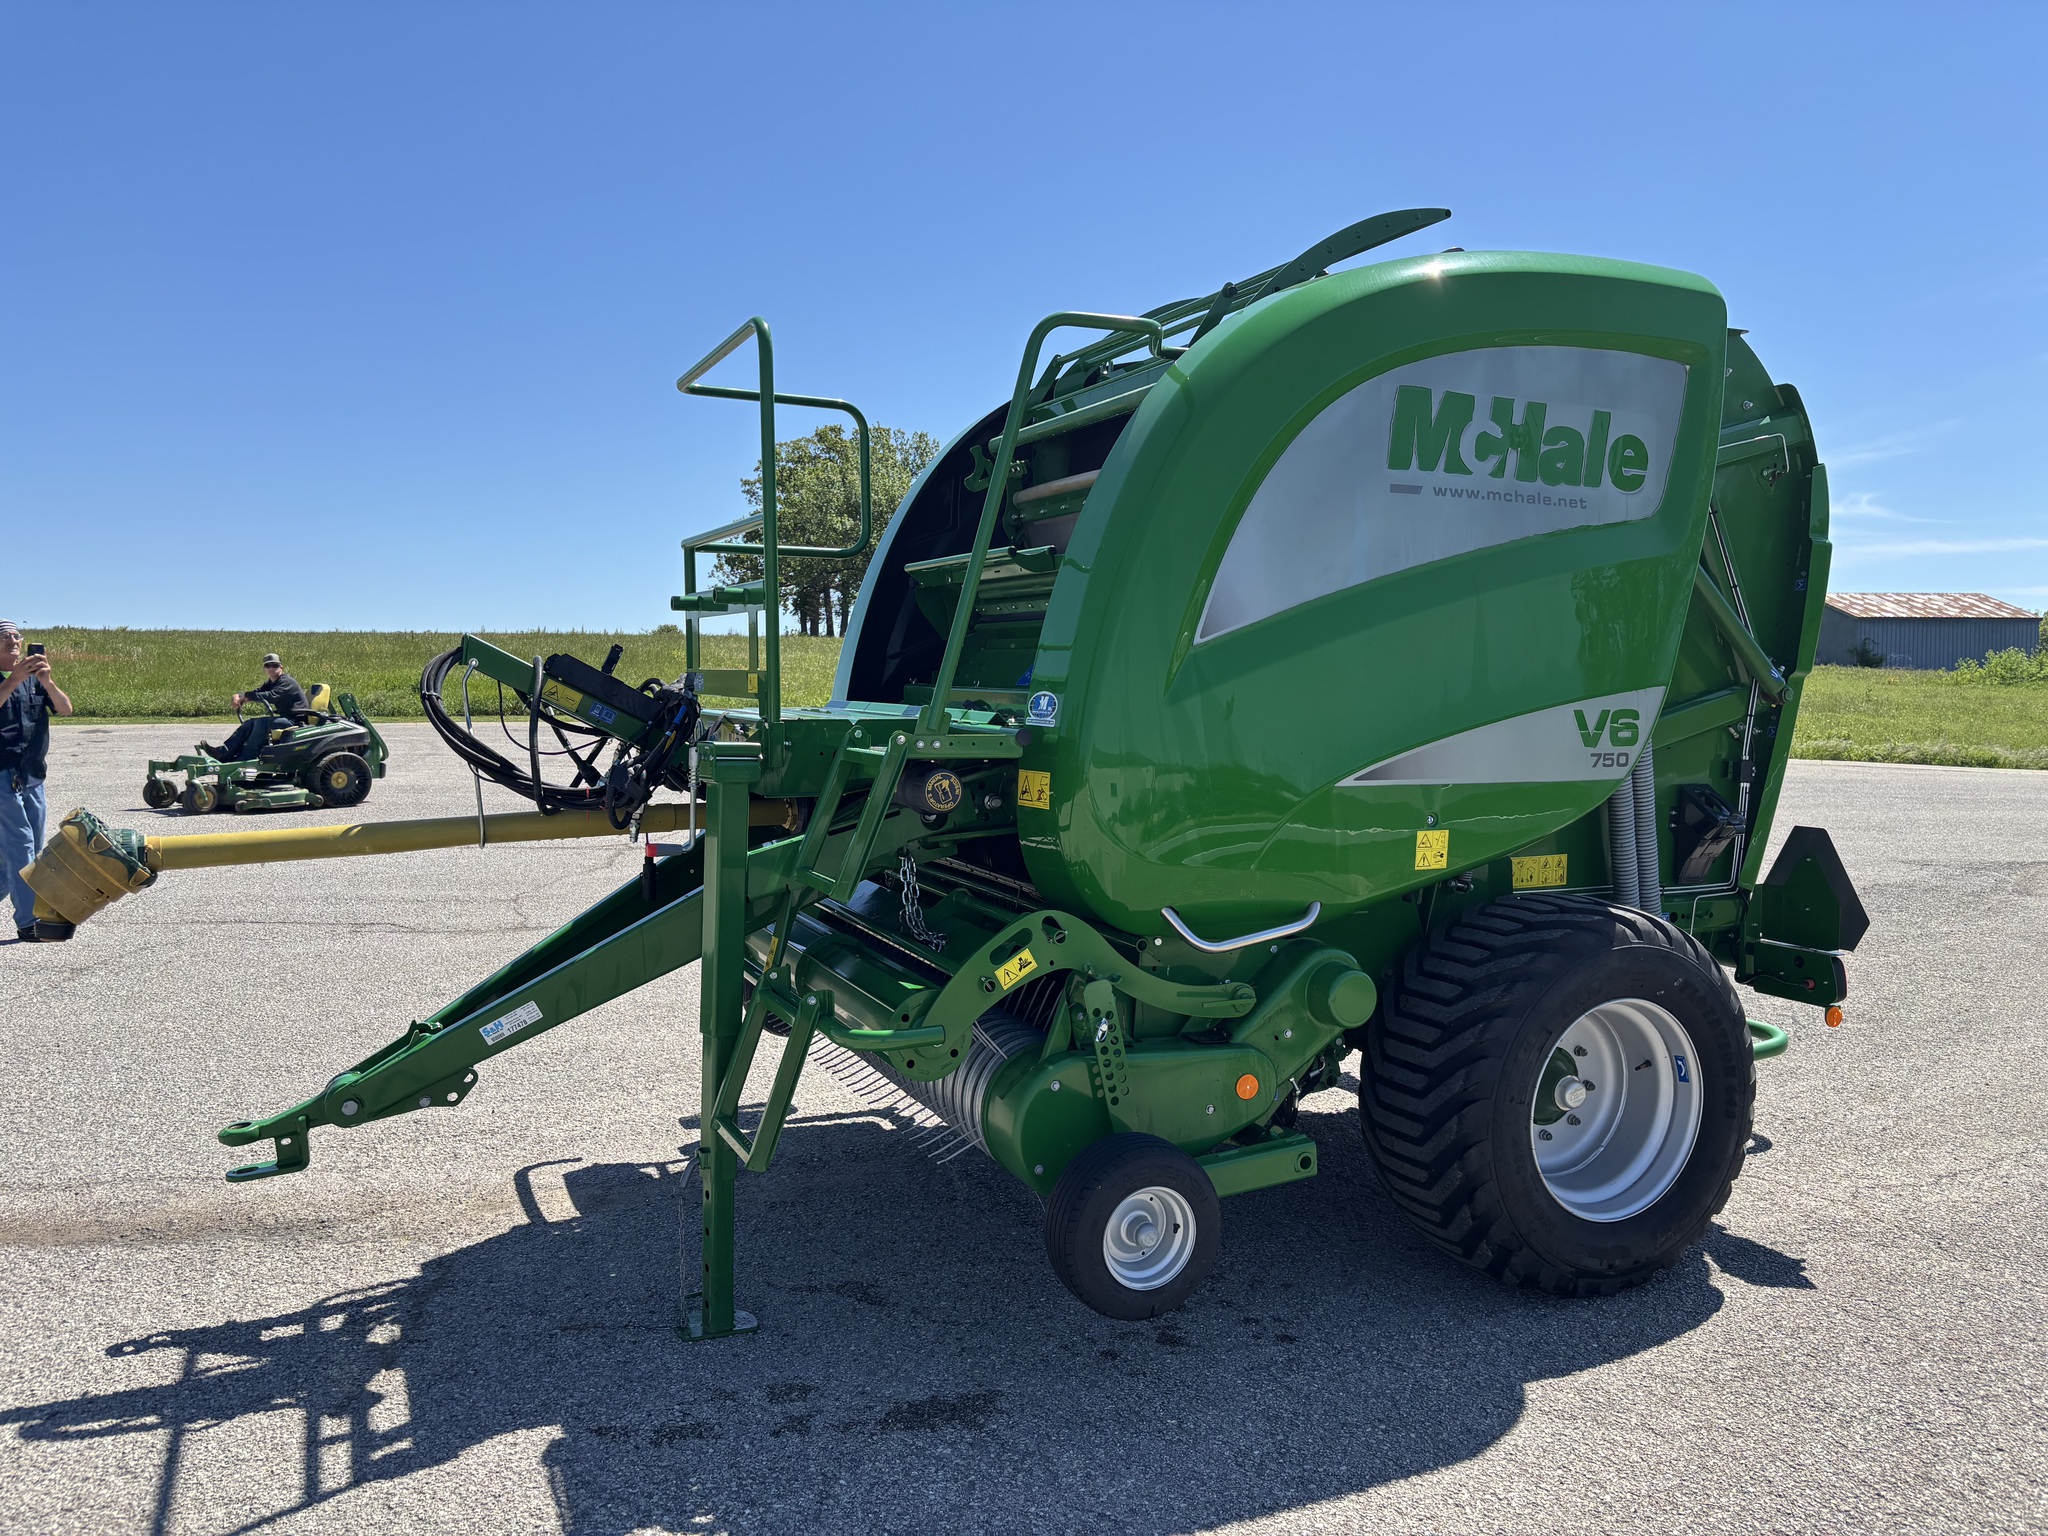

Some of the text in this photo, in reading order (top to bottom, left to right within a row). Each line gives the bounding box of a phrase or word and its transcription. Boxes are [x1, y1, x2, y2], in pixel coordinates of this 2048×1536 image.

[1387, 384, 1649, 493] McHale
[1433, 485, 1588, 510] www.mchale.net
[1573, 708, 1640, 749] V6
[1590, 752, 1630, 769] 750
[927, 774, 943, 791] MANUAL
[507, 1019, 528, 1034] 177478
